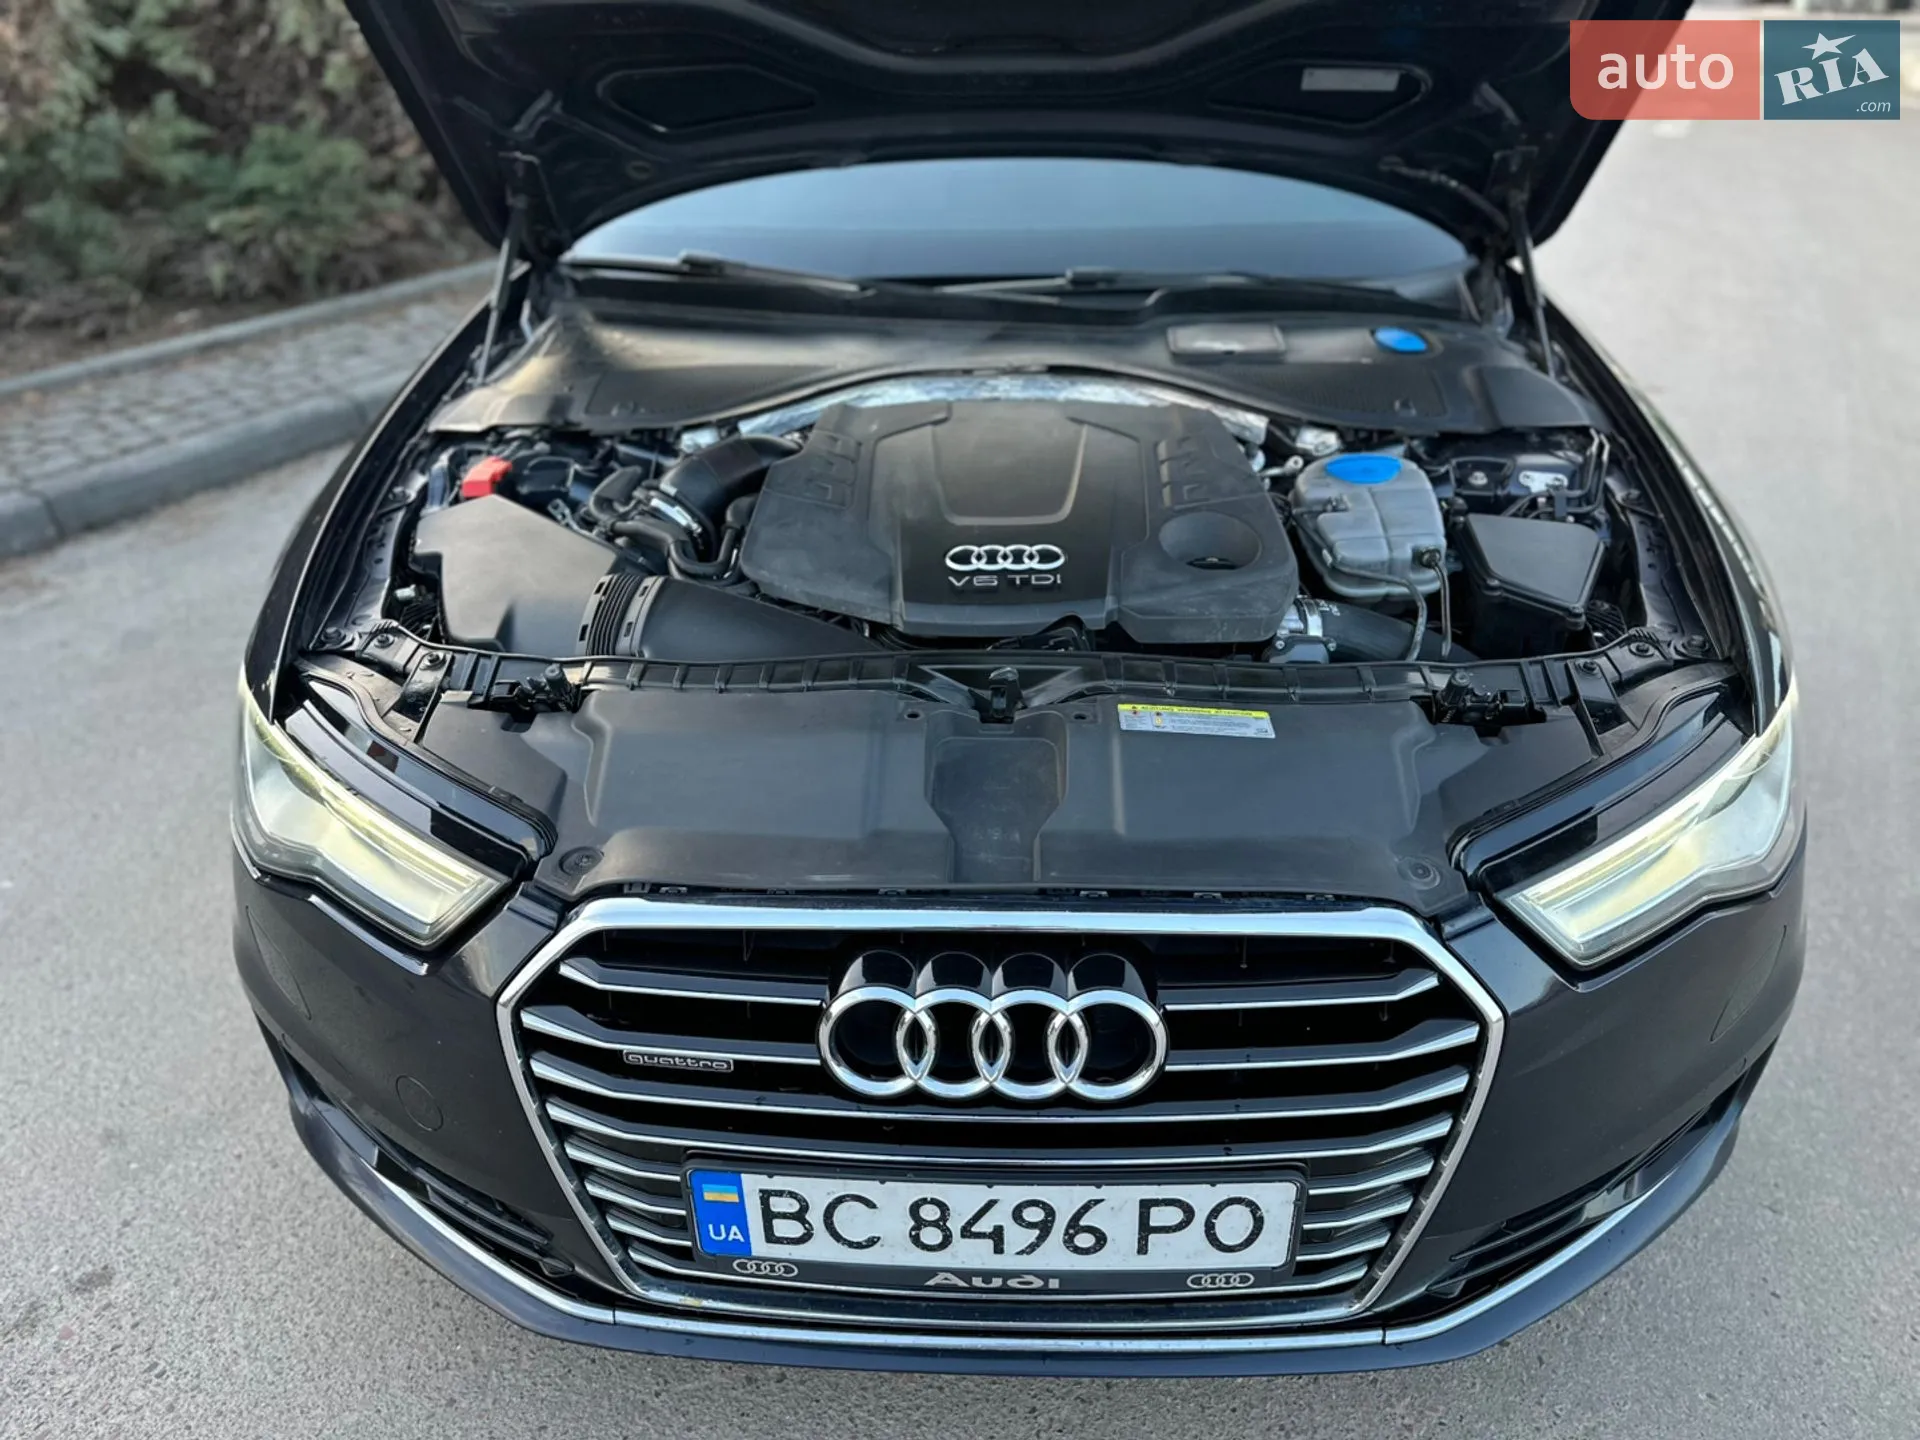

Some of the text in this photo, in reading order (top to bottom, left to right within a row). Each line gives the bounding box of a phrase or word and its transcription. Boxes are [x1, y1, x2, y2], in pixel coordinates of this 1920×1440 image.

[947, 573, 1062, 587] V6 TDI
[627, 1053, 728, 1070] quattro
[758, 1188, 1265, 1256] BC 8496 PO
[708, 1223, 745, 1243] UA
[923, 1271, 1060, 1289] Audi
